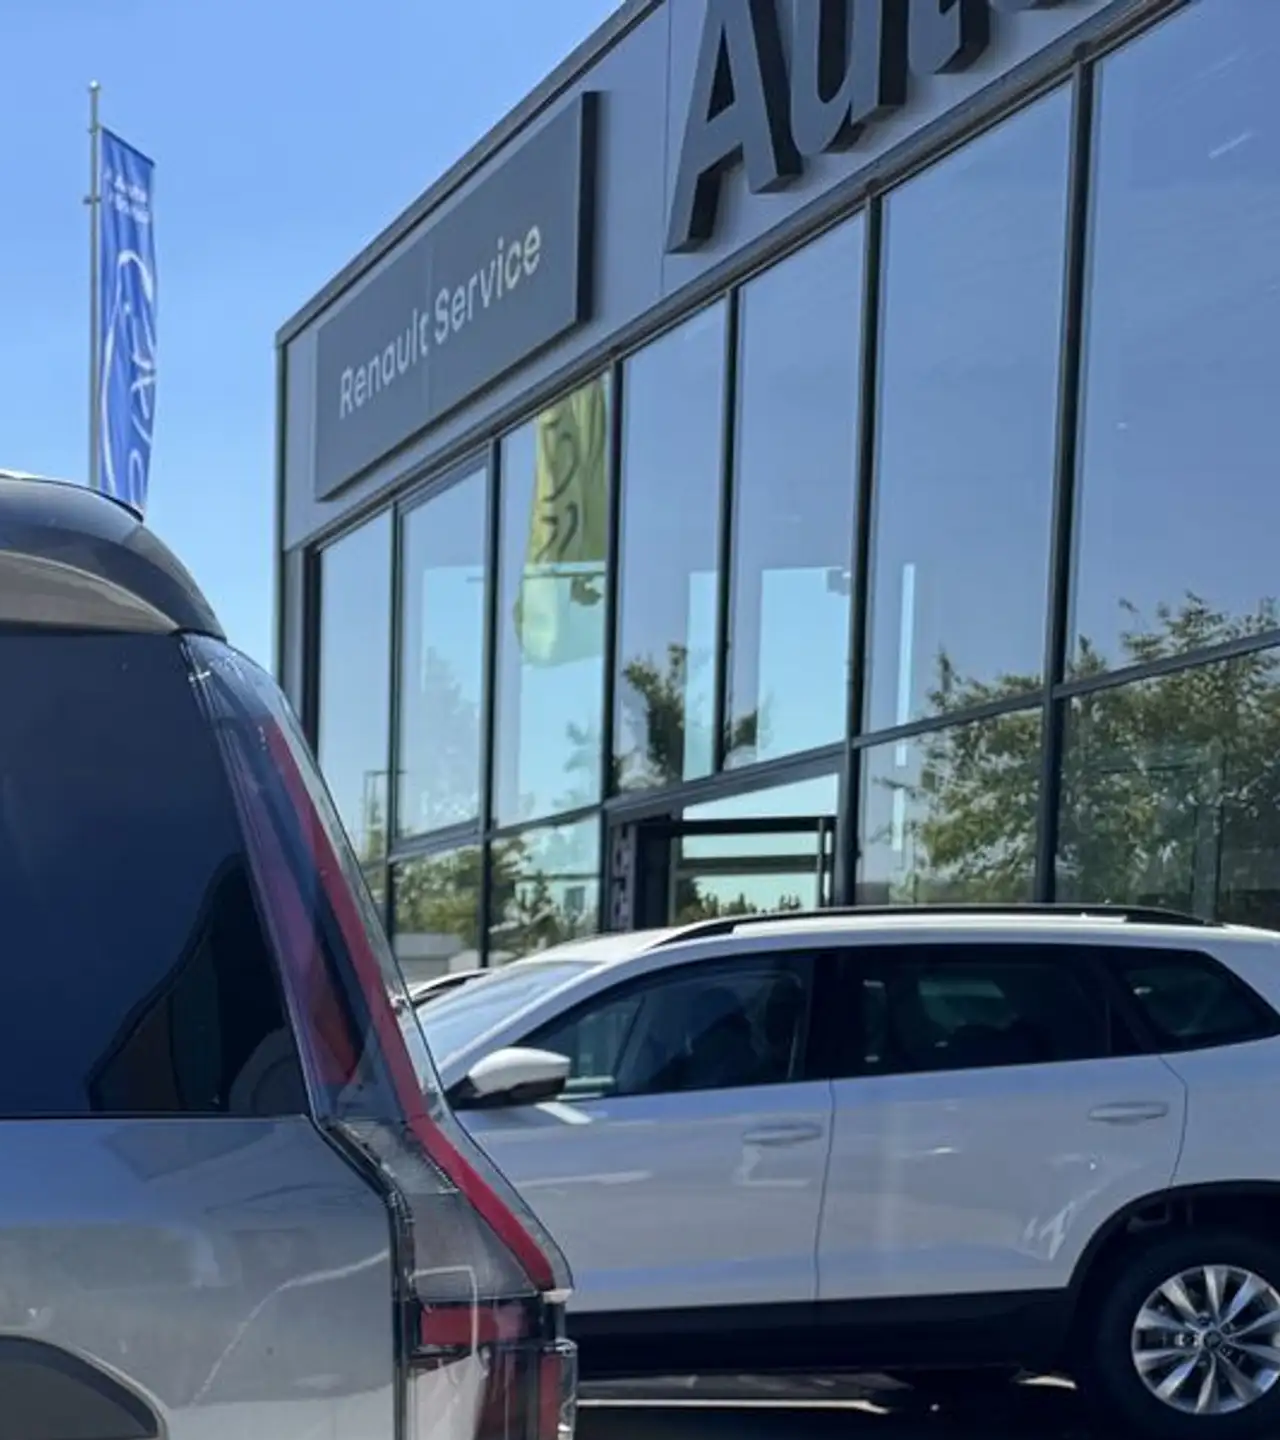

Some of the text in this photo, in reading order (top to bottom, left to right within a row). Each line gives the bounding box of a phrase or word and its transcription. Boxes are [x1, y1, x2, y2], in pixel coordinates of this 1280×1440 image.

[666, 0, 1062, 254] Au
[339, 225, 541, 420] Renault Service
